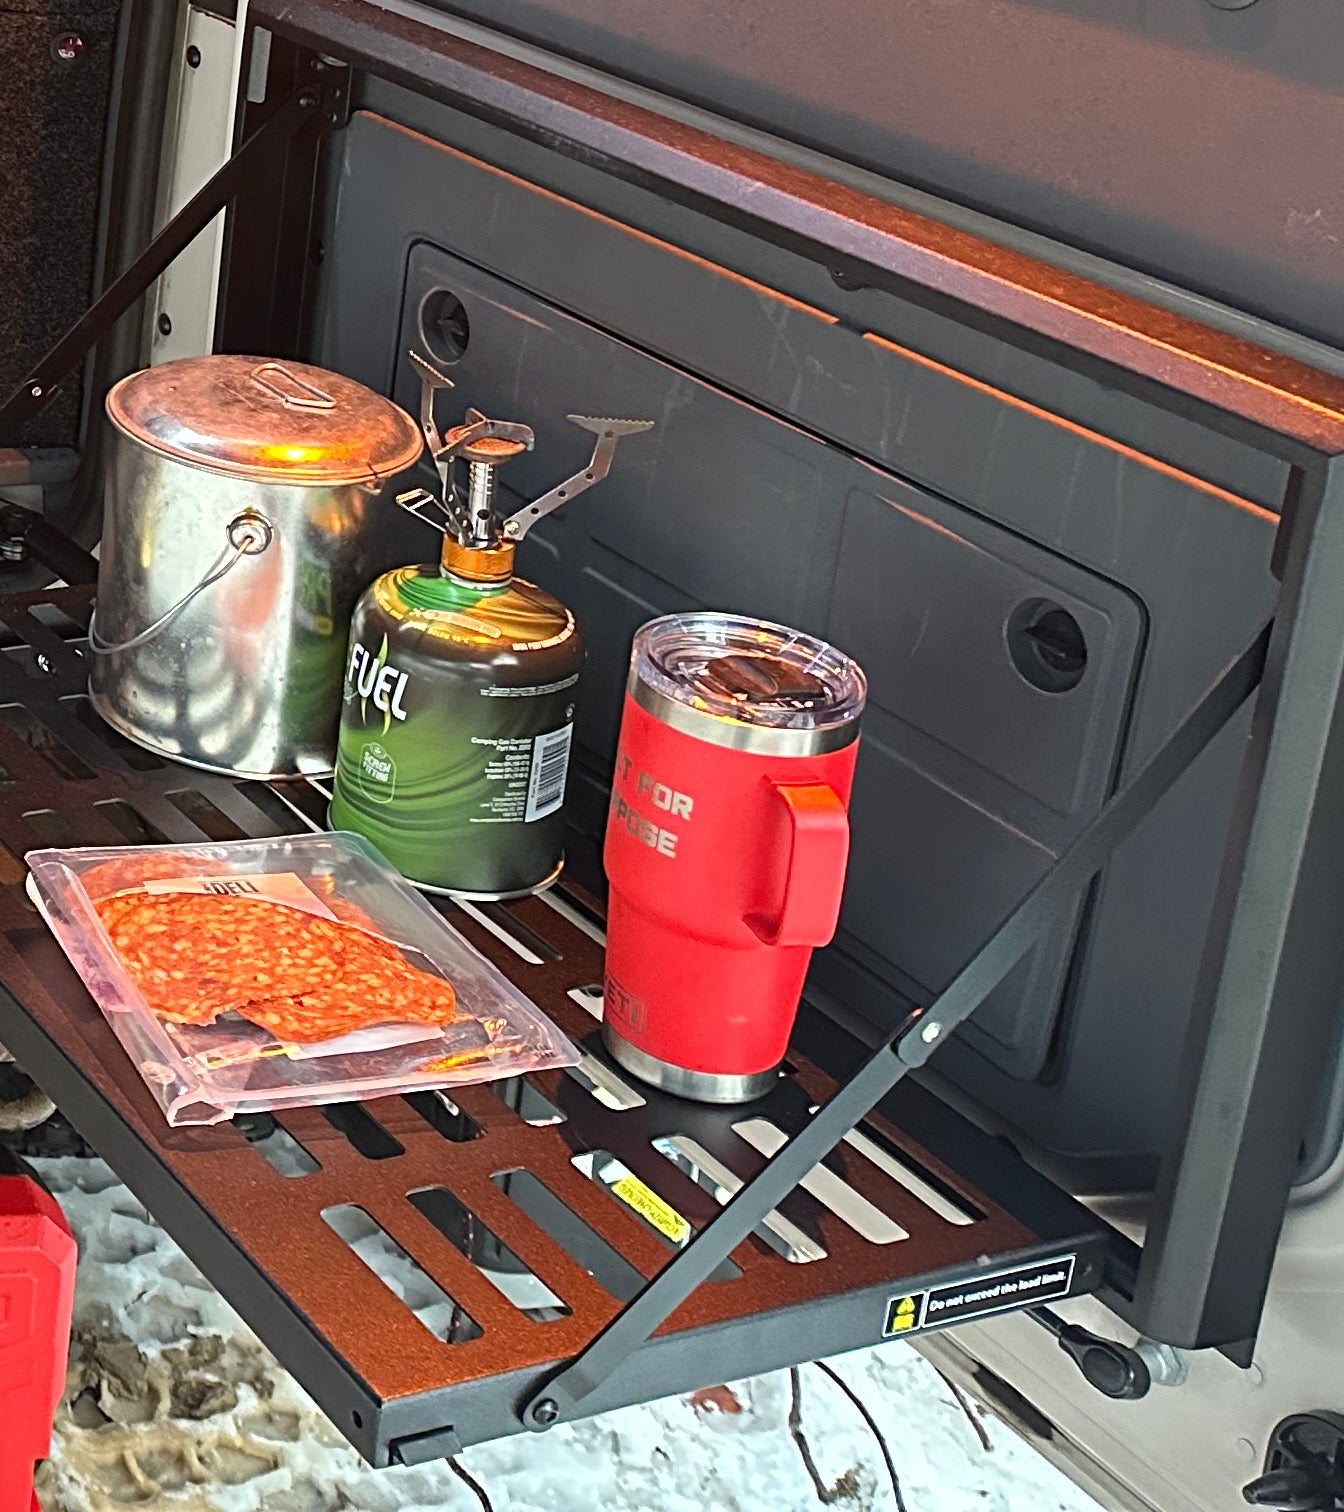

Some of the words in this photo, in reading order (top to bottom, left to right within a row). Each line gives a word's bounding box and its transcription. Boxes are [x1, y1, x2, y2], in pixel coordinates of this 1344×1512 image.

[348, 642, 409, 721] FUEL
[637, 771, 694, 822] FOR
[210, 879, 261, 896] DELI
[929, 1299, 945, 1312] Do
[946, 1295, 964, 1307] not
[964, 1286, 1001, 1304] exceed
[1001, 1282, 1017, 1296] the
[1019, 1276, 1042, 1291] load
